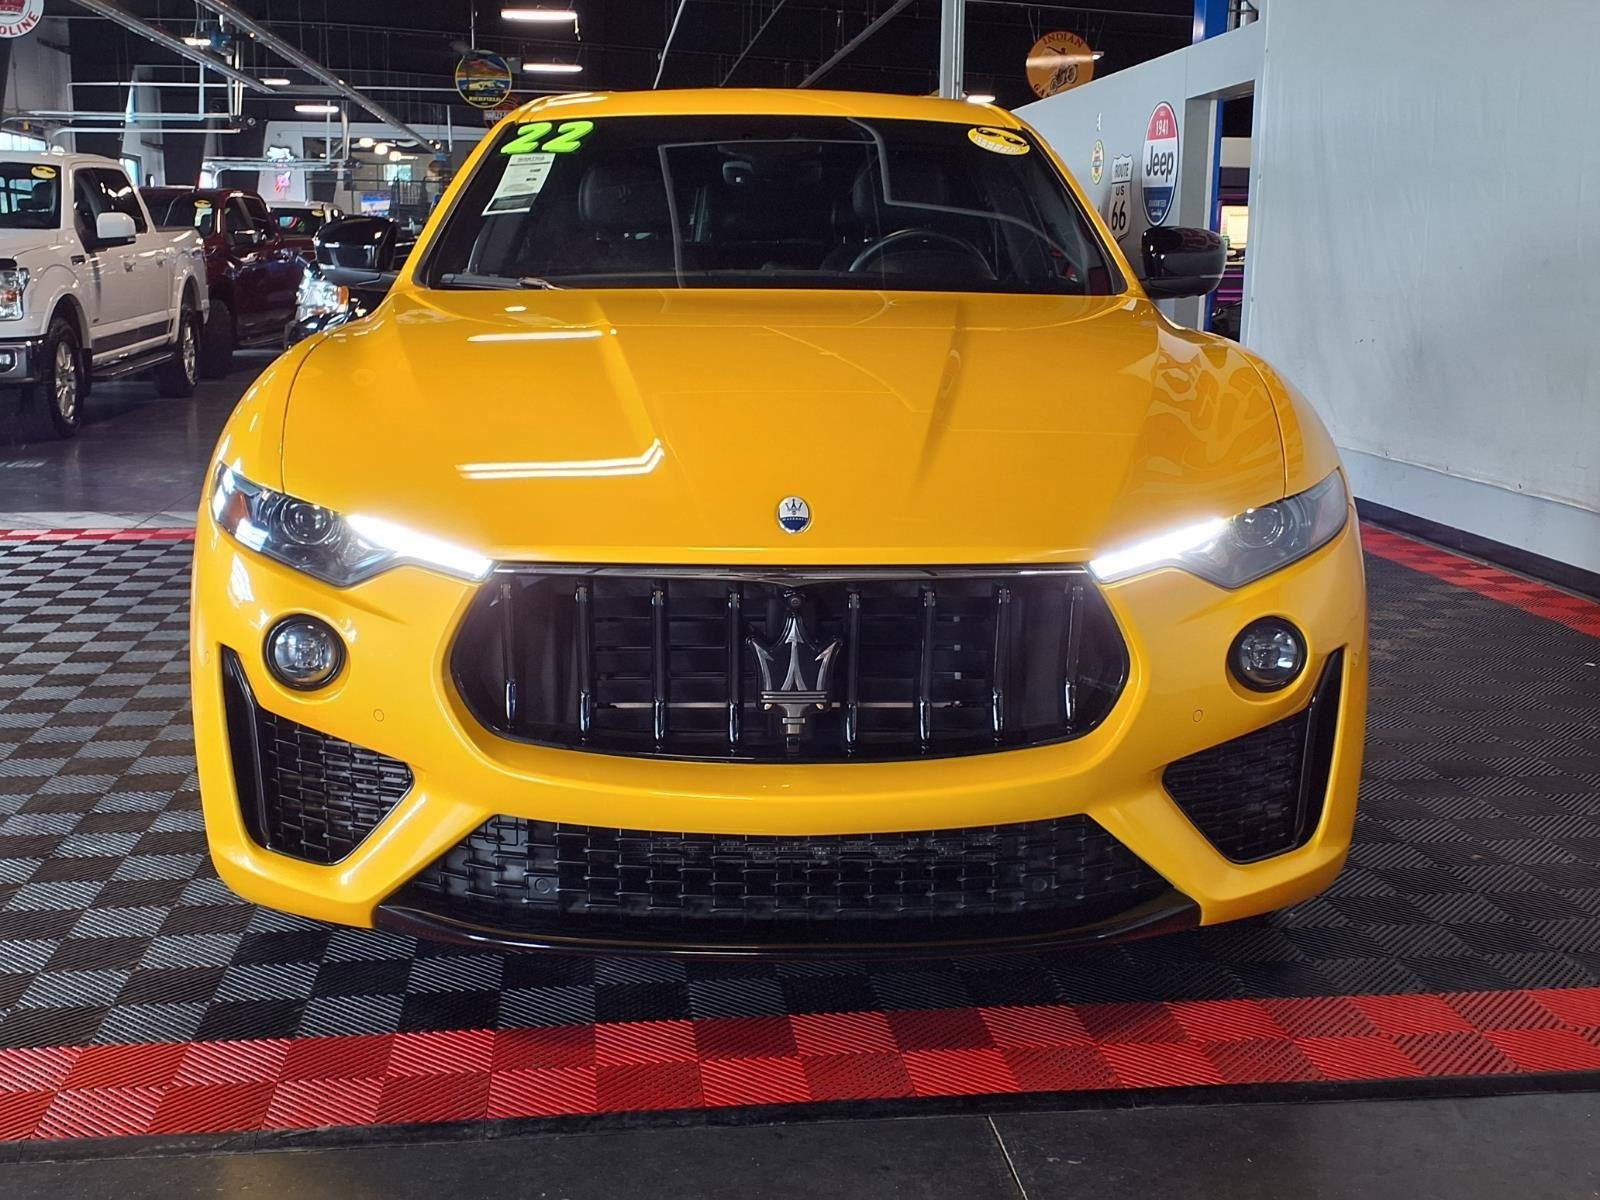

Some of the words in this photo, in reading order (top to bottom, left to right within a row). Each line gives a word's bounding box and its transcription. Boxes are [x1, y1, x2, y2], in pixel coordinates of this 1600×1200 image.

[1042, 32, 1084, 49] INDIAN
[1155, 119, 1169, 136] 1941
[500, 120, 593, 154] 22
[1115, 162, 1129, 178] ROUTE
[1146, 146, 1174, 182] Jeep
[1115, 185, 1125, 196] US
[1112, 201, 1127, 230] 66
